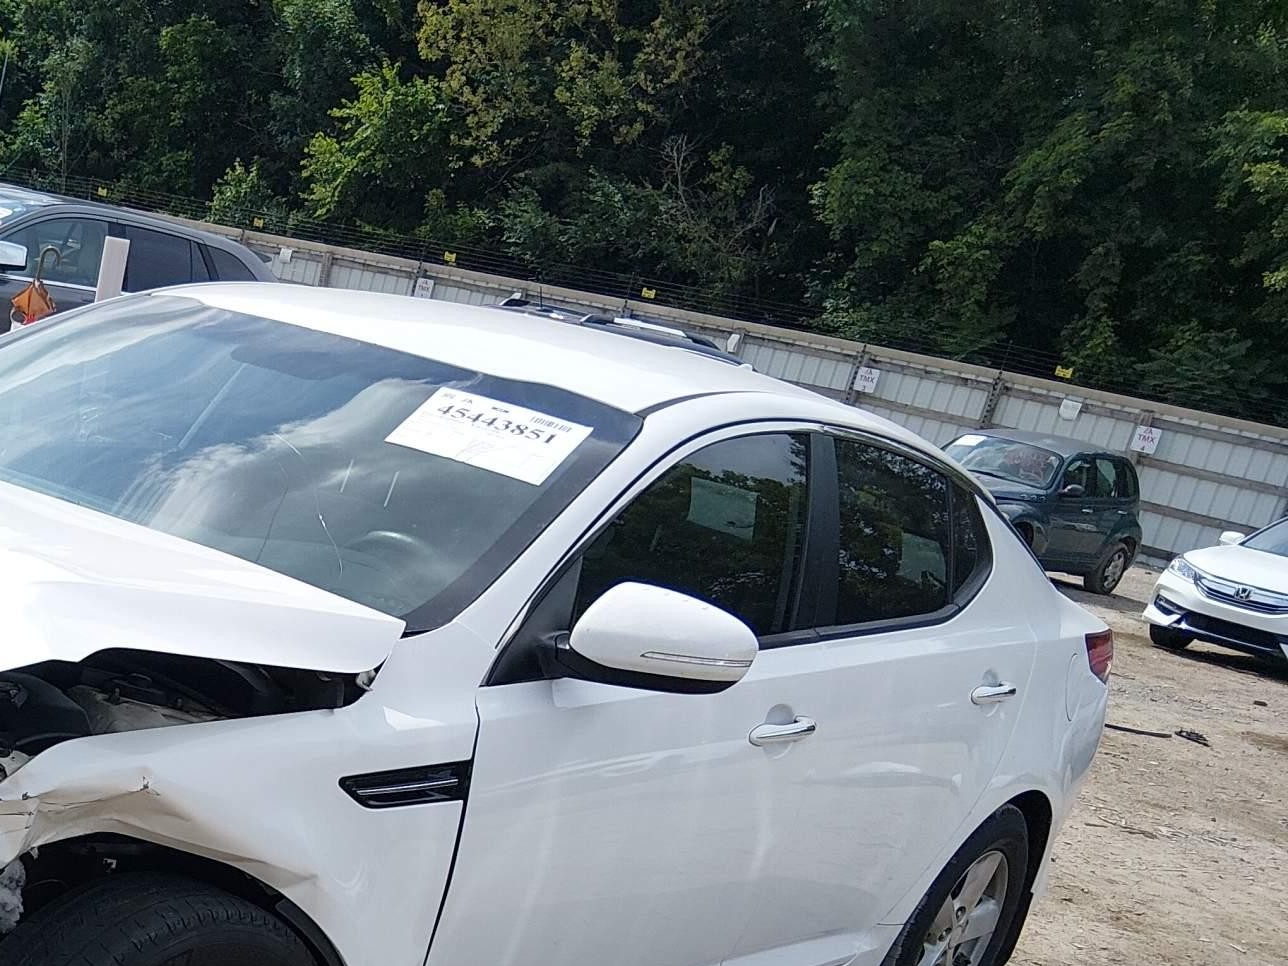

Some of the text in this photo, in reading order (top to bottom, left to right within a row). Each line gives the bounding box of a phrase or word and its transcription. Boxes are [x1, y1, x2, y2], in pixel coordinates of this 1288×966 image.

[859, 374, 876, 384] TMX
[437, 404, 557, 444] 45443851
[1137, 433, 1156, 445] TMX
